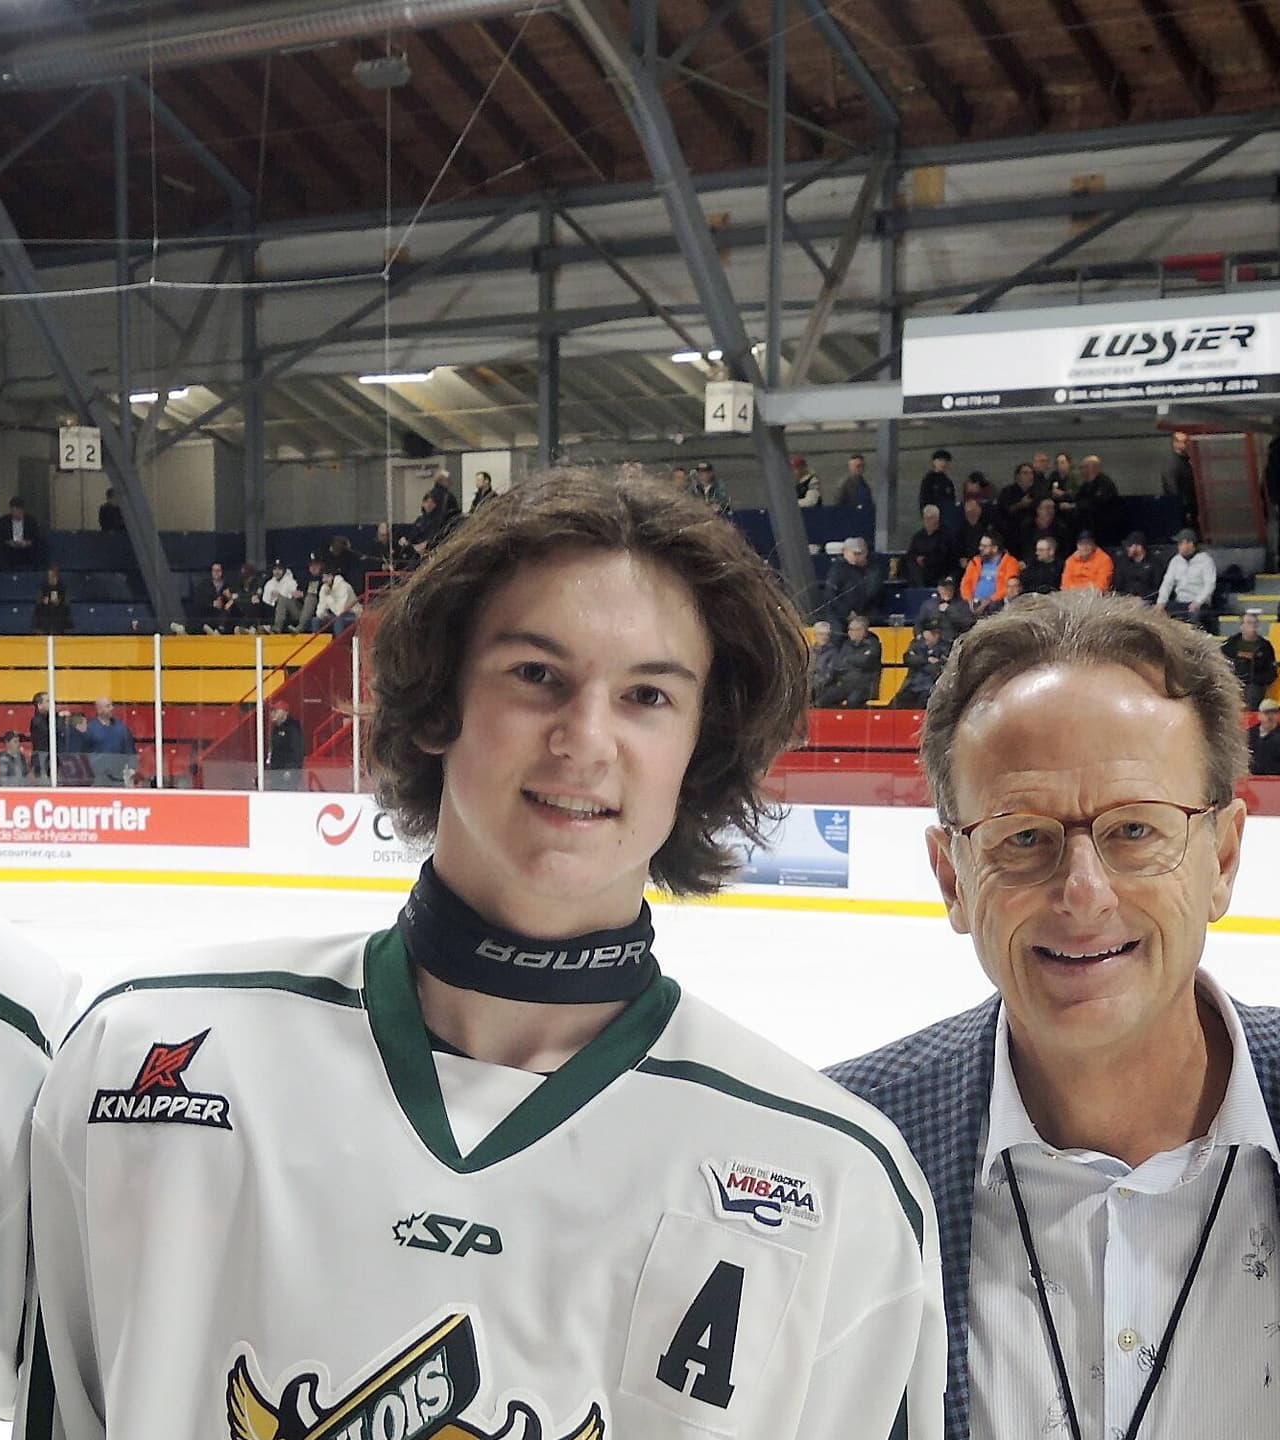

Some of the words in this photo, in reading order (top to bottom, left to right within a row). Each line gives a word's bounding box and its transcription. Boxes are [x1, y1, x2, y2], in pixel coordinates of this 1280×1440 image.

[1080, 325, 1255, 367] LUSSIER
[33, 798, 151, 831] Courrier
[14, 830, 98, 843] Saint-Hyacinthe
[475, 938, 647, 970] BAUER
[96, 1095, 225, 1122] KNAPPER
[770, 1172, 805, 1189] HOCKEY
[407, 1213, 503, 1257] SP
[656, 1260, 746, 1409] A
